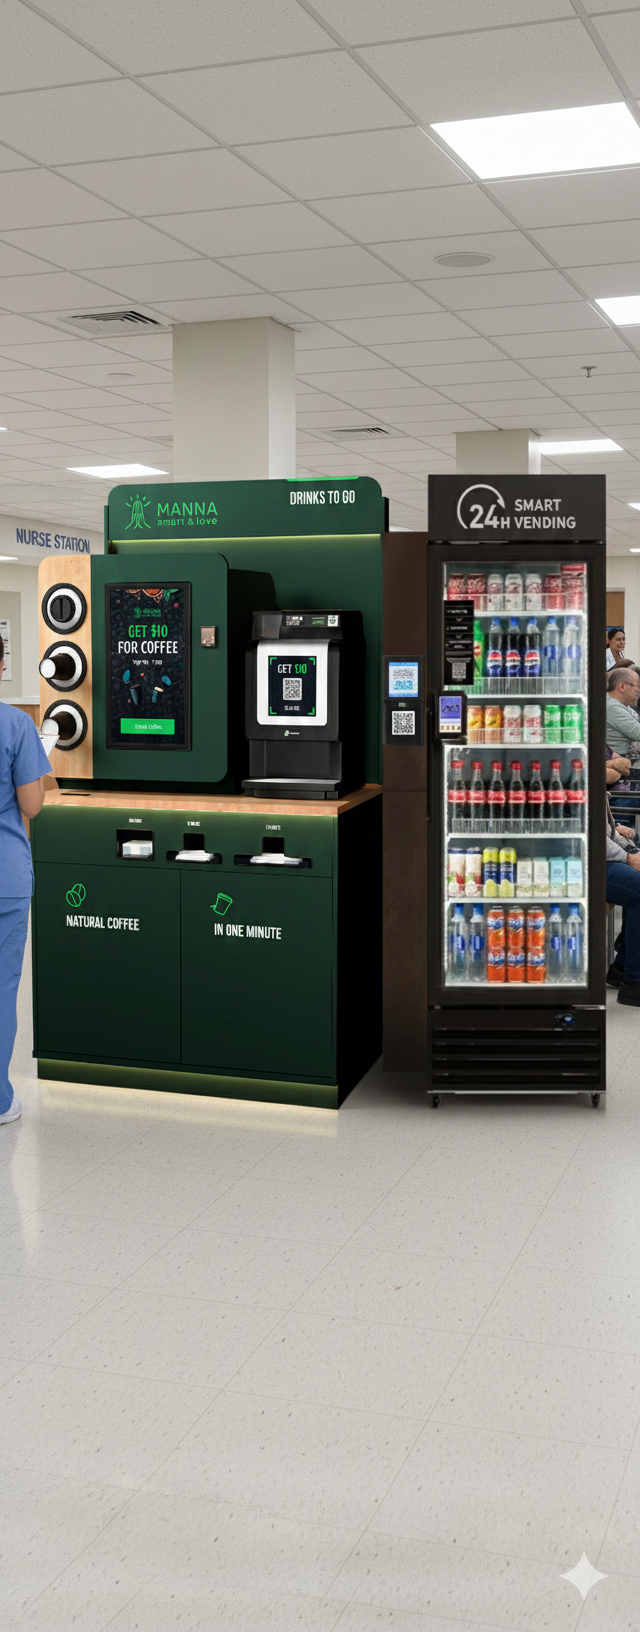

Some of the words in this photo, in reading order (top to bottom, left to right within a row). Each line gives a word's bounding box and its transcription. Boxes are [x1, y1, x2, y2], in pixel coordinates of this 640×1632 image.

[289, 490, 326, 505] DRINKS
[327, 490, 340, 504] TO
[342, 489, 356, 504] GO
[157, 501, 218, 516] MANNA
[514, 498, 562, 512] SMART
[196, 516, 218, 526] love
[513, 516, 577, 529] VENDING
[16, 527, 52, 548] NURSE
[54, 534, 91, 554] STATION
[128, 624, 148, 638] GET
[118, 640, 138, 654] FOR
[140, 640, 179, 654] COFFEE
[277, 663, 293, 674] GET
[66, 914, 106, 929] NATURAL
[107, 917, 140, 931] COFFEE
[214, 923, 224, 936] IN
[225, 923, 245, 937] ONE
[246, 925, 282, 940] MINUTE
